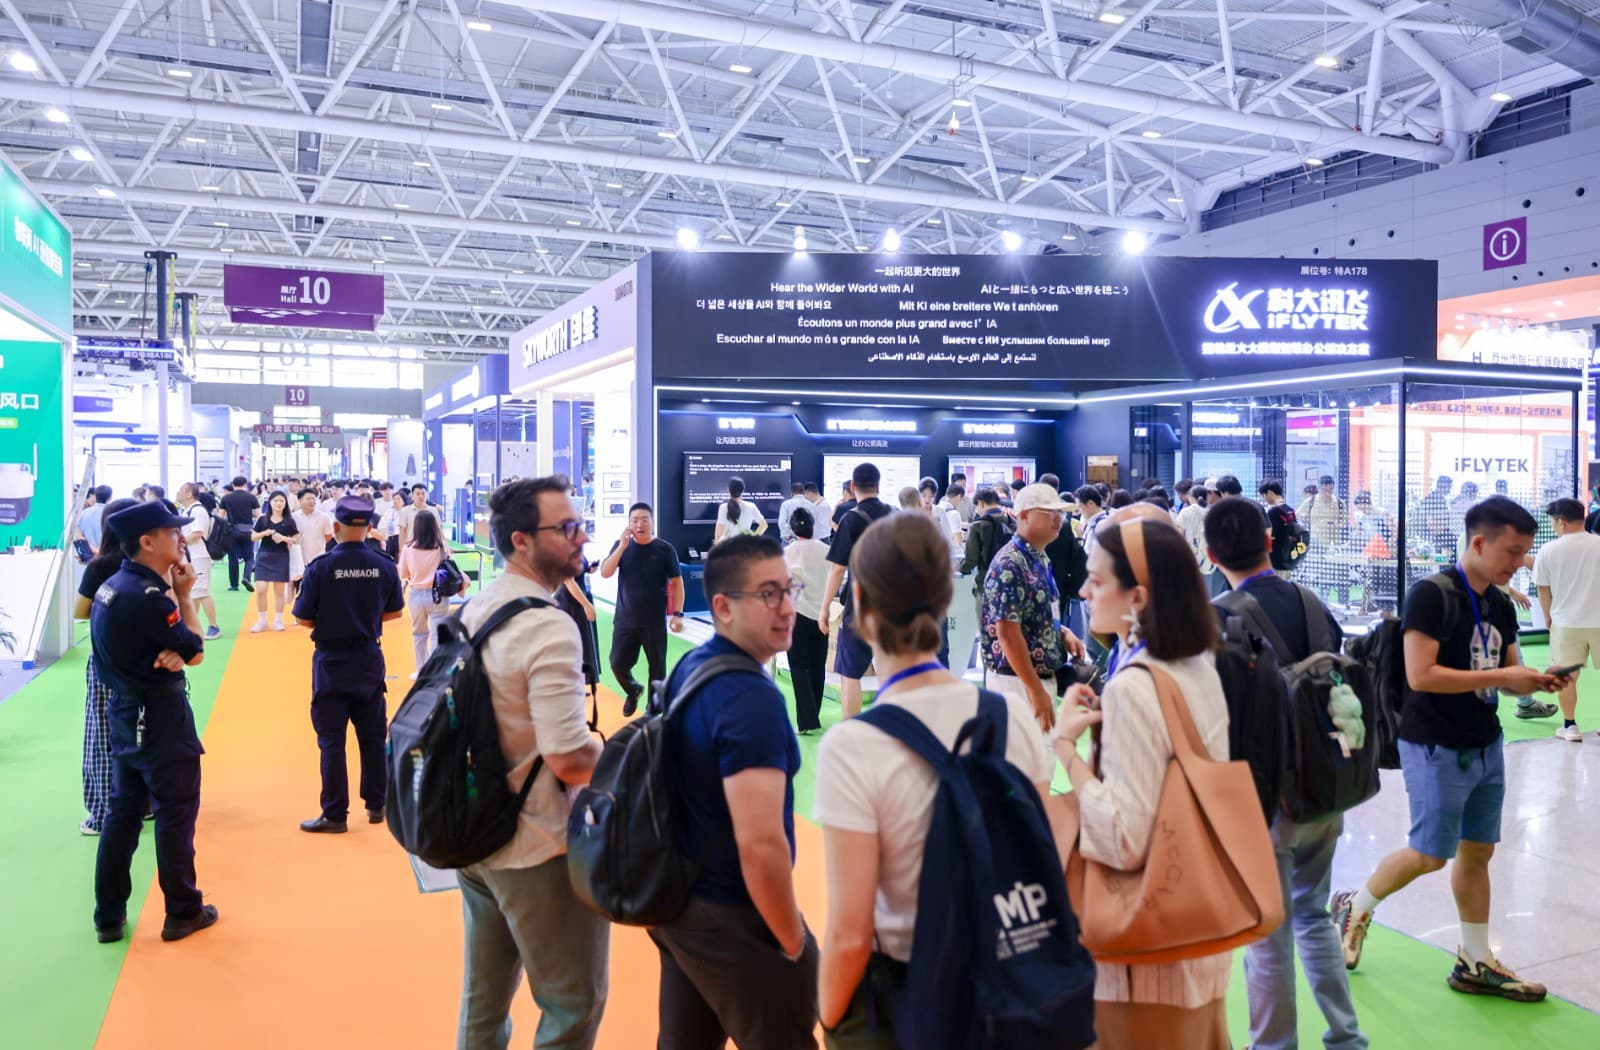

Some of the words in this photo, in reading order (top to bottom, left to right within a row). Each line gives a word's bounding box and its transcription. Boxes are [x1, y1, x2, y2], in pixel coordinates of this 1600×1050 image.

[874, 265, 961, 277] 一起听见更大的世界
[280, 294, 297, 303] Hall
[299, 276, 331, 305] 10
[770, 282, 795, 293] Hear
[797, 282, 814, 293] the
[815, 282, 846, 293] Wider
[847, 282, 878, 293] World
[879, 282, 901, 293] with
[902, 282, 914, 293] AI
[696, 299, 705, 309] 더
[727, 299, 754, 310] 세상을
[776, 299, 795, 310] 함께
[899, 300, 915, 311] Mit
[916, 300, 928, 311] KI
[929, 301, 951, 311] eine
[952, 301, 991, 312] breitere
[797, 315, 844, 328] Écoutons
[844, 318, 858, 328] un
[859, 318, 894, 328] monde
[895, 318, 916, 330] plus
[917, 318, 948, 330] grand
[948, 320, 973, 329] avec
[716, 333, 765, 344] Escuchar
[766, 333, 776, 344] al
[777, 334, 812, 344] mundo
[839, 334, 876, 346] grande
[876, 336, 896, 345] con
[942, 335, 977, 345] Вместе
[984, 335, 1000, 345] ИИ
[1000, 337, 1046, 347] услышим
[1046, 335, 1090, 345] больший
[1091, 338, 1111, 348] мир
[289, 388, 306, 402] 10
[1454, 456, 1530, 474] iFLYTEK
[993, 883, 1048, 929] MP
